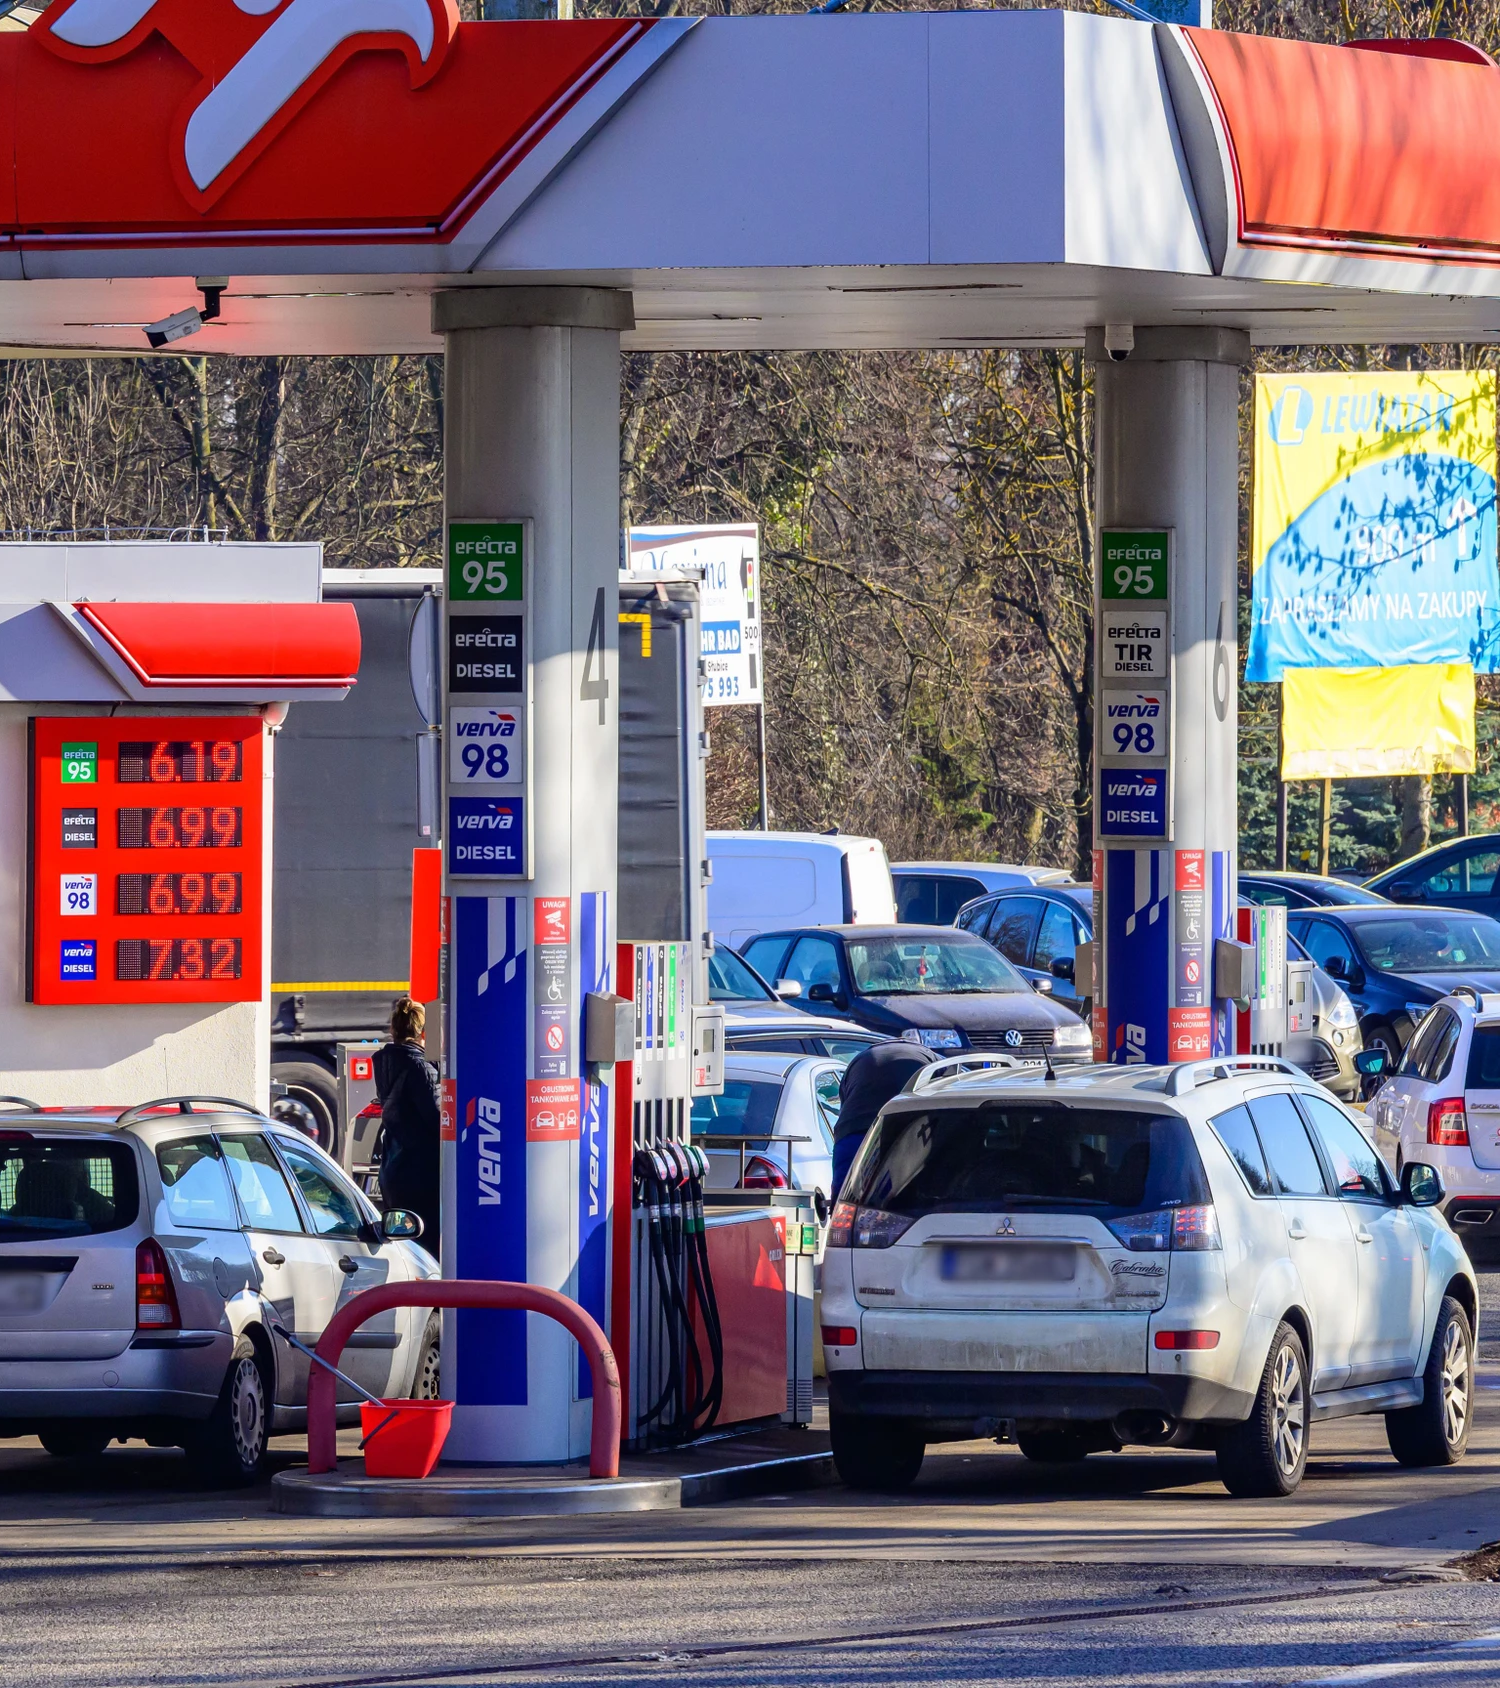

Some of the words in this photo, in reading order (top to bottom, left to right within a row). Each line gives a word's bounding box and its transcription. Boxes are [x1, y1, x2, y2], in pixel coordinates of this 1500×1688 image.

[1321, 389, 1454, 434] LEWIATAN
[455, 536, 516, 555] efecta
[1107, 544, 1161, 560] efecta
[1356, 525, 1403, 564] 900
[1414, 533, 1436, 563] m
[462, 561, 508, 594] 95
[1113, 566, 1154, 594] 95
[1260, 592, 1380, 624] ZAPRASZAMY
[1387, 593, 1413, 621] NA
[1418, 590, 1488, 620] ZAKUPY
[455, 628, 516, 647] efecta
[744, 626, 759, 639] 500
[1108, 623, 1161, 639] efecta
[717, 630, 740, 651] BAD
[580, 587, 609, 725] 4
[1114, 644, 1152, 661] TIR
[456, 664, 516, 678] DIESEL
[1115, 662, 1154, 672] DIESEL
[1212, 601, 1229, 723] 6
[719, 676, 740, 698] 993
[1108, 702, 1160, 718] verva
[456, 719, 516, 737] verva
[1112, 723, 1155, 753] 98
[64, 749, 95, 760] efecta
[151, 741, 236, 782] 6.19
[461, 744, 509, 778] 98
[67, 762, 91, 780] 95
[1108, 782, 1157, 797] verva
[64, 815, 95, 825] efecta
[456, 813, 513, 829] verva
[1107, 810, 1159, 824] DIESEL
[149, 807, 236, 847] 6.99
[65, 833, 95, 841] DIESEL
[456, 846, 516, 860] DIESEL
[64, 881, 92, 890] verva
[149, 873, 236, 914] 6.99
[67, 892, 90, 909] 98
[63, 948, 93, 957] verva
[149, 939, 235, 980] 7.32
[63, 964, 94, 973] DIESEL
[478, 1097, 501, 1206] verva
